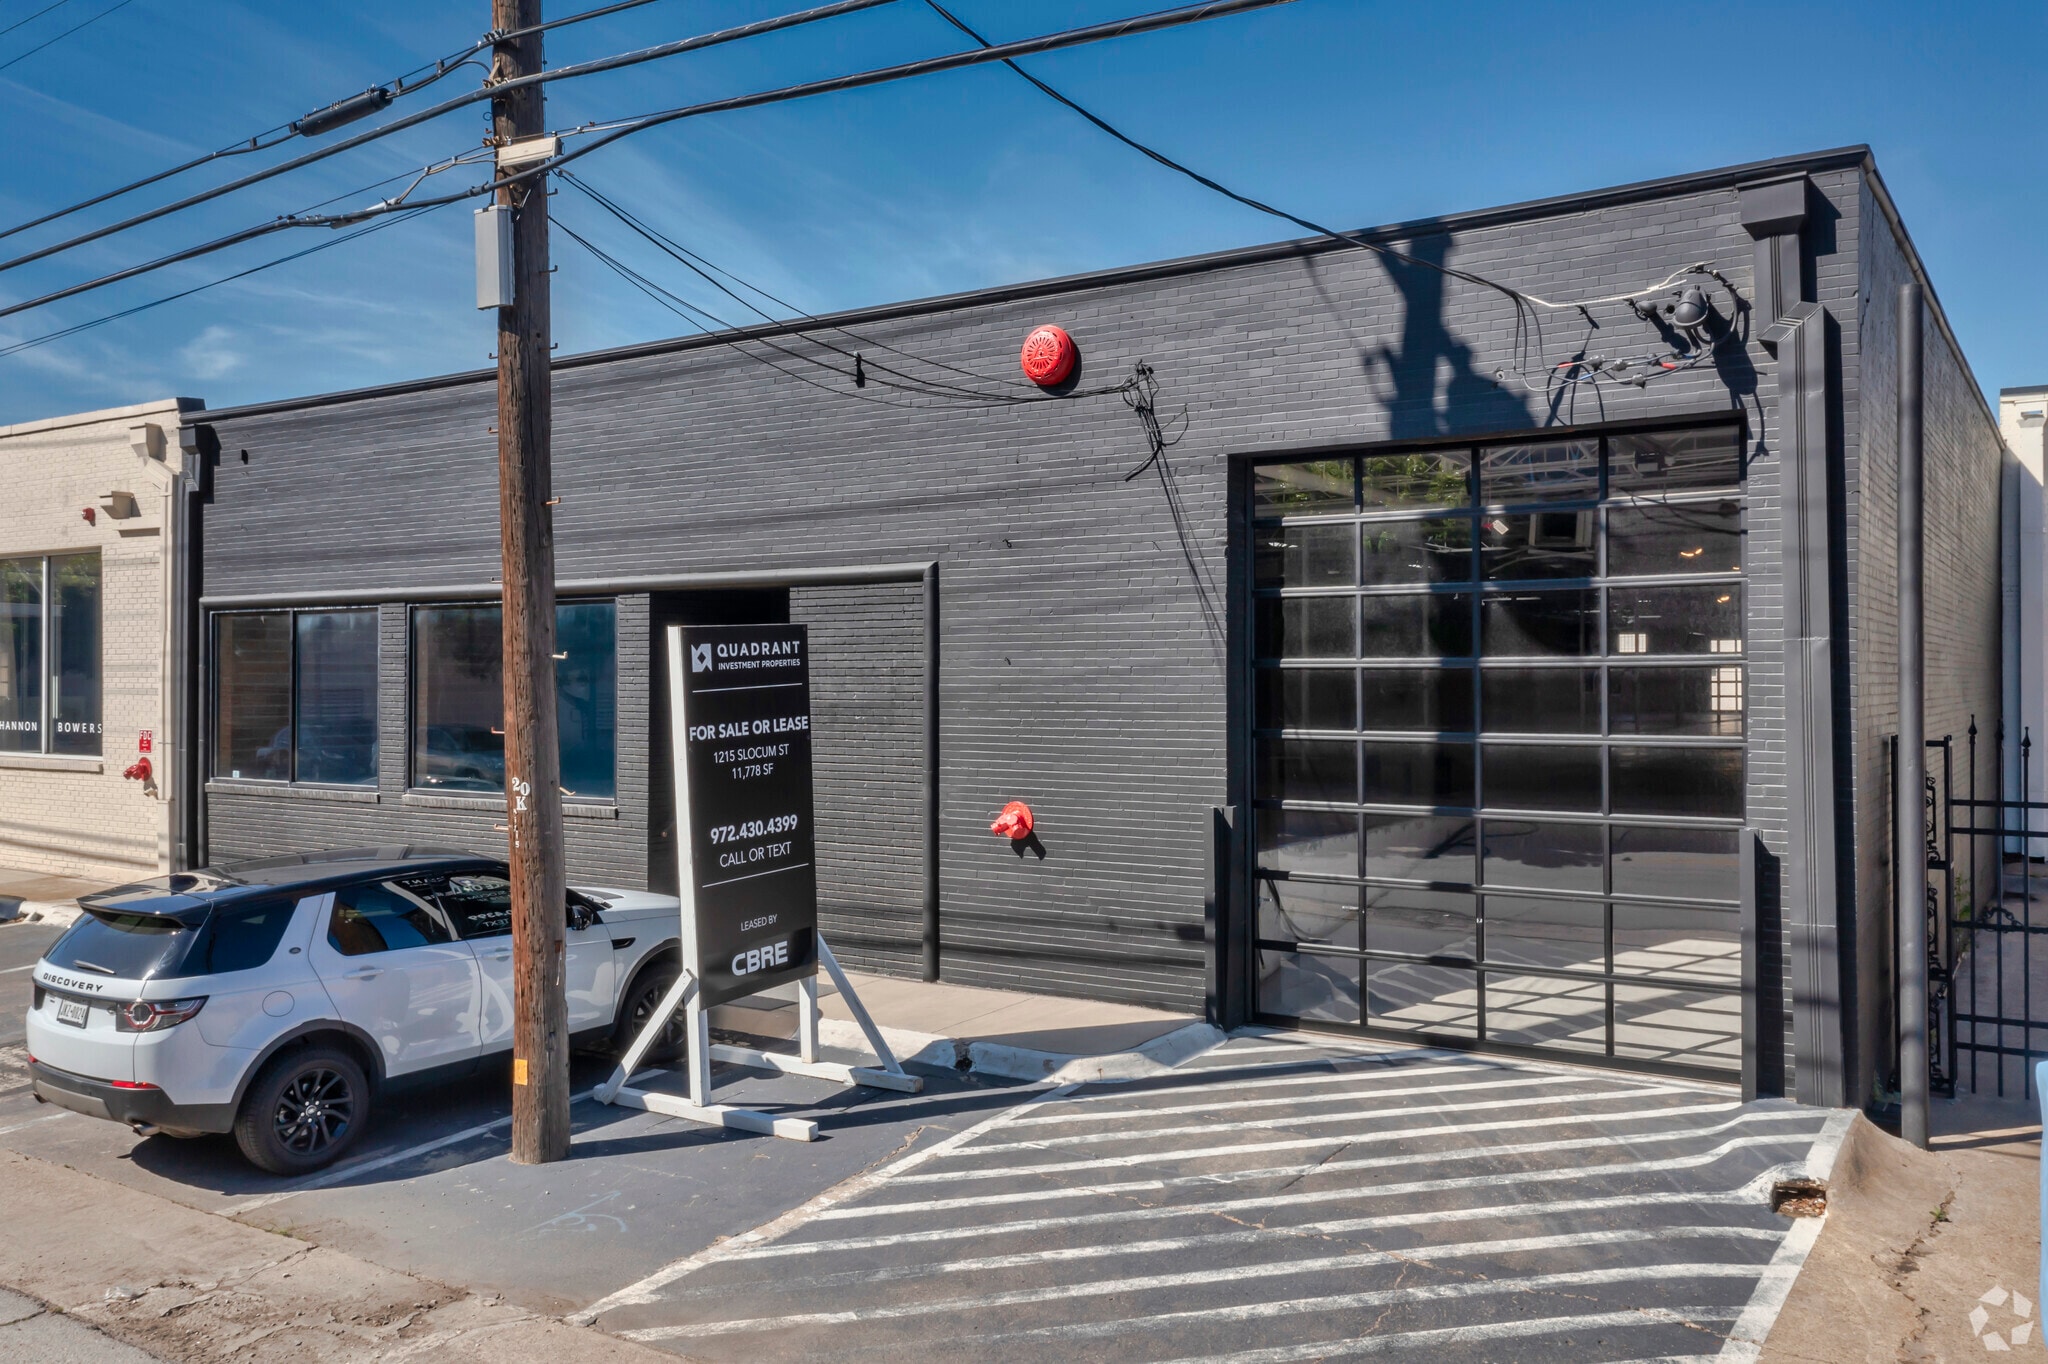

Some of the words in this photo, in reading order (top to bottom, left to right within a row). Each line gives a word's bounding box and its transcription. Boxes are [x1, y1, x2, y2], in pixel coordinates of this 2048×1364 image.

[717, 641, 800, 658] QUADRANT
[718, 660, 760, 670] INVESTMENT
[761, 658, 801, 668] PROPERTIES
[57, 722, 103, 734] BOWERS
[689, 726, 716, 741] FOR
[719, 721, 749, 738] SALE
[752, 719, 770, 735] OR
[773, 716, 809, 732] LEASE
[713, 750, 735, 764] 1215
[737, 746, 776, 761] SLOCUM
[778, 743, 789, 755] ST
[732, 765, 761, 781] 11,778
[762, 763, 774, 774] SF
[710, 814, 798, 845] 972.430.4399
[719, 850, 747, 868] CALL
[748, 846, 765, 862] OR
[766, 841, 792, 858] TEXT
[740, 916, 767, 932] LEASED
[768, 914, 778, 924] BY
[731, 940, 788, 976] CBRE
[43, 972, 103, 992] DISCOVERY
